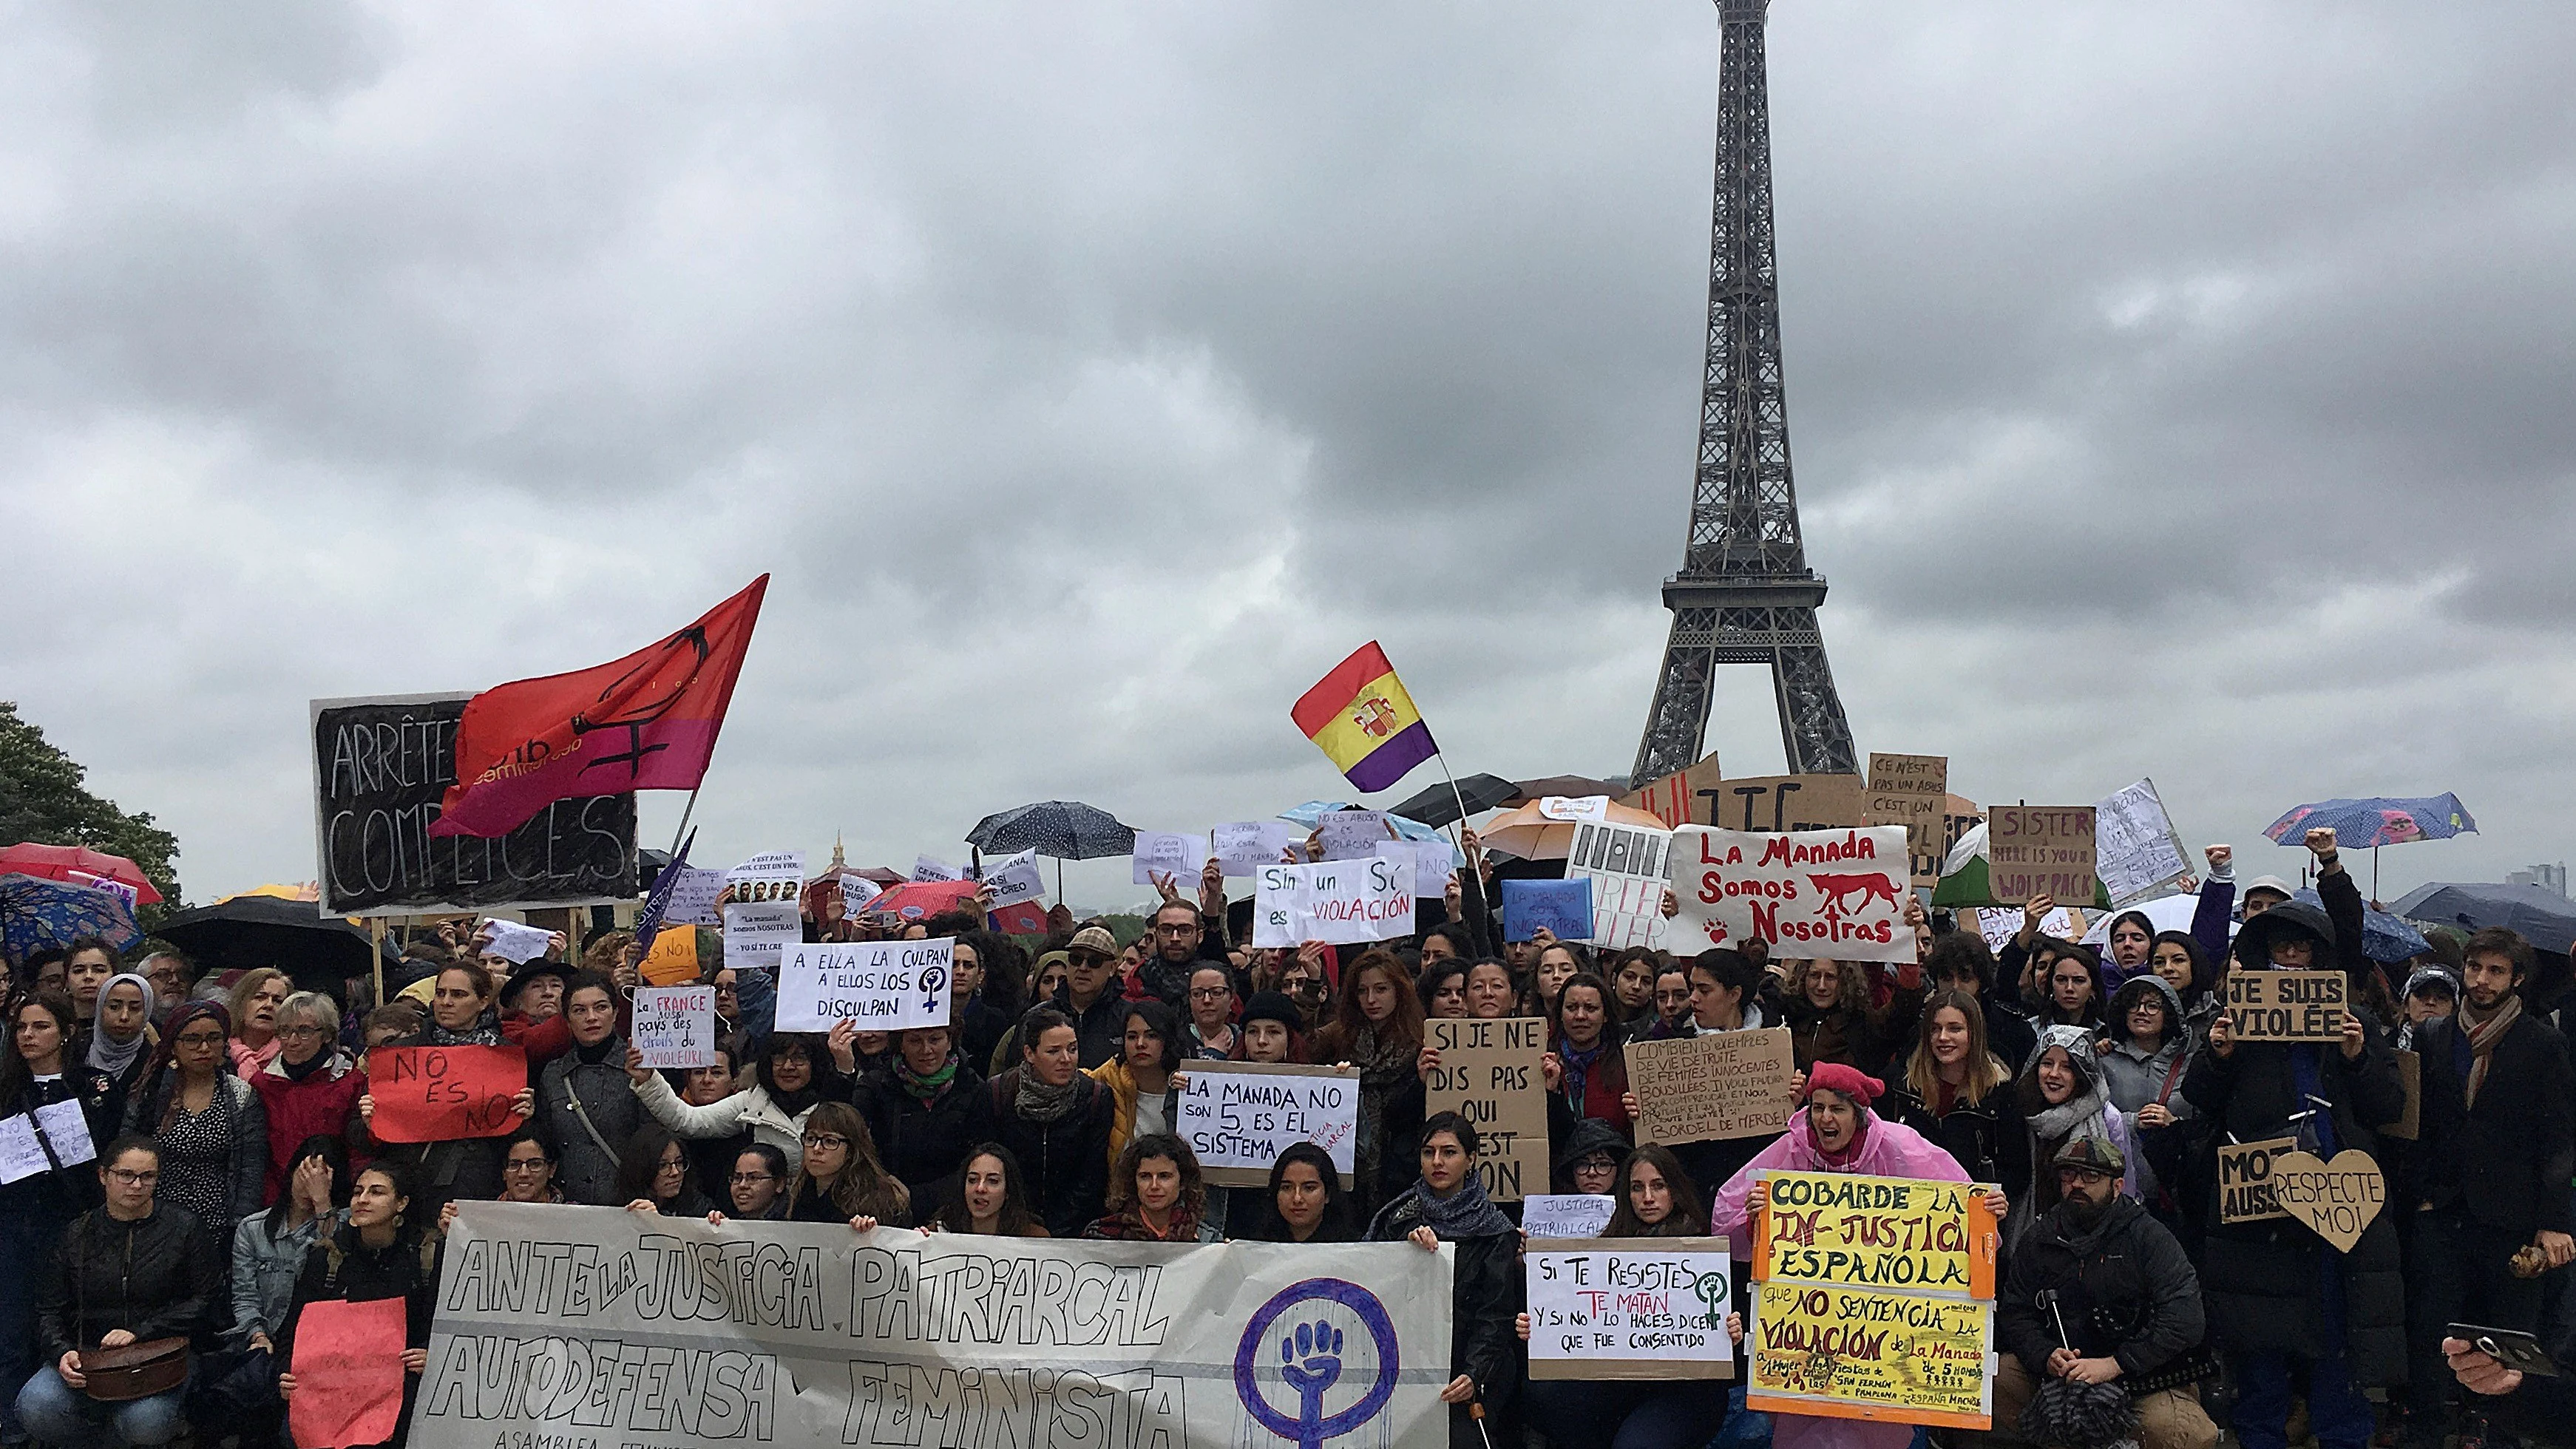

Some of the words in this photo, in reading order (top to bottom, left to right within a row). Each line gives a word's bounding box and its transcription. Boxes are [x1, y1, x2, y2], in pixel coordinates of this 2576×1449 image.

[1876, 759, 1891, 771] CE
[1896, 758, 1929, 775] N'EST
[1874, 779, 1894, 790] PAS
[1898, 781, 1913, 790] UN
[1916, 781, 1942, 793] ABUS
[1874, 796, 1905, 810] C'EST
[1914, 800, 1933, 812] UN
[2002, 809, 2089, 836] SISTER
[1230, 853, 1244, 862] TU
[1426, 859, 1450, 875] NO
[2033, 848, 2045, 863] IS
[2052, 849, 2088, 864] YOUR
[842, 882, 853, 890] NO
[855, 885, 865, 893] ES
[1001, 882, 1026, 895] CREO
[1265, 869, 1295, 891] Sin
[1316, 875, 1335, 890] un
[1370, 861, 1401, 892] Sí
[1998, 874, 2045, 900] WOLF
[2050, 873, 2091, 897] PACK
[845, 892, 867, 901] BUSO
[1270, 910, 1287, 925] es
[1313, 889, 1410, 922] VIOLACIÓN
[757, 923, 794, 932] NOSOTRAS
[793, 953, 806, 968] A
[818, 953, 856, 970] ELLA
[870, 951, 889, 967] LA
[902, 948, 949, 968] CULPAN
[818, 973, 827, 986] A
[838, 973, 875, 989] ELLOS
[880, 971, 910, 991] LOS
[2230, 977, 2261, 1003] JE
[2278, 978, 2342, 1004] SUIS
[657, 995, 706, 1012] FRANCE
[638, 1019, 665, 1036] pays
[673, 1019, 691, 1030] des
[2230, 1005, 2342, 1037] VIOLÉE
[643, 1031, 673, 1049] droits
[682, 1030, 695, 1048] du
[1434, 1023, 1458, 1050] SI
[1467, 1022, 1494, 1048] JE
[1505, 1021, 1540, 1050] NE
[1636, 1042, 1698, 1060] COMBIEN
[394, 1050, 447, 1084] NO
[1636, 1060, 1655, 1072] DE
[1657, 1059, 1678, 1072] VIE
[1638, 1074, 1655, 1085] DE
[1658, 1068, 1707, 1082] FEMMES
[1432, 1066, 1470, 1091] DIS
[1491, 1065, 1529, 1092] PAS
[426, 1081, 468, 1103] ES
[1186, 1077, 1210, 1098] LA
[1222, 1083, 1299, 1110] MANADA
[1309, 1085, 1342, 1109] NO
[1745, 1089, 1769, 1098] NOUS
[466, 1085, 510, 1131] NO
[1185, 1104, 1211, 1117] SON
[1254, 1113, 1275, 1131] ES
[1286, 1112, 1309, 1134] EL
[1651, 1121, 1715, 1138] BORDEL
[1720, 1120, 1732, 1130] DE
[1739, 1109, 1789, 1129] MERDE!
[1193, 1132, 1276, 1160] SISTEMA
[1479, 1161, 1520, 1196] ON
[2274, 1173, 2384, 1203] RESPECTE
[1543, 1199, 1604, 1212] JUSTICIA
[1772, 1178, 1911, 1210] COBARDE
[1928, 1188, 1965, 1215] LA
[2225, 1184, 2280, 1218] AUSS
[2312, 1206, 2365, 1233] MOI
[448, 1239, 600, 1317] ANTE
[600, 1251, 636, 1311] LA
[1539, 1258, 1557, 1280] SI
[1565, 1257, 1590, 1286] TE
[1608, 1257, 1697, 1291] RESISTES
[1777, 1249, 1970, 1286] ESPAÑOLA
[1534, 1306, 1545, 1327] Y
[1550, 1311, 1563, 1326] SI
[1570, 1311, 1588, 1326] NO
[1604, 1311, 1619, 1326] LO
[1630, 1313, 1675, 1330] HACES,
[1576, 1291, 1609, 1320] TE
[1616, 1292, 1668, 1314] MATAN
[1764, 1286, 1792, 1309] que
[1788, 1289, 1829, 1317] NO
[1956, 1319, 1980, 1337] LA
[1561, 1334, 1584, 1354] QUE
[1593, 1333, 1616, 1350] FUE
[1629, 1332, 1705, 1350] CONSENTIDO
[1759, 1318, 1888, 1361] VIOLACIÓN
[1891, 1334, 1904, 1351] de
[1909, 1333, 1926, 1357] La
[1931, 1341, 1983, 1360] Manada
[1757, 1352, 1767, 1362] a
[1942, 1363, 1951, 1375] 5
[1874, 1367, 1883, 1376] de
[427, 1335, 776, 1441] AUTODEFENSA
